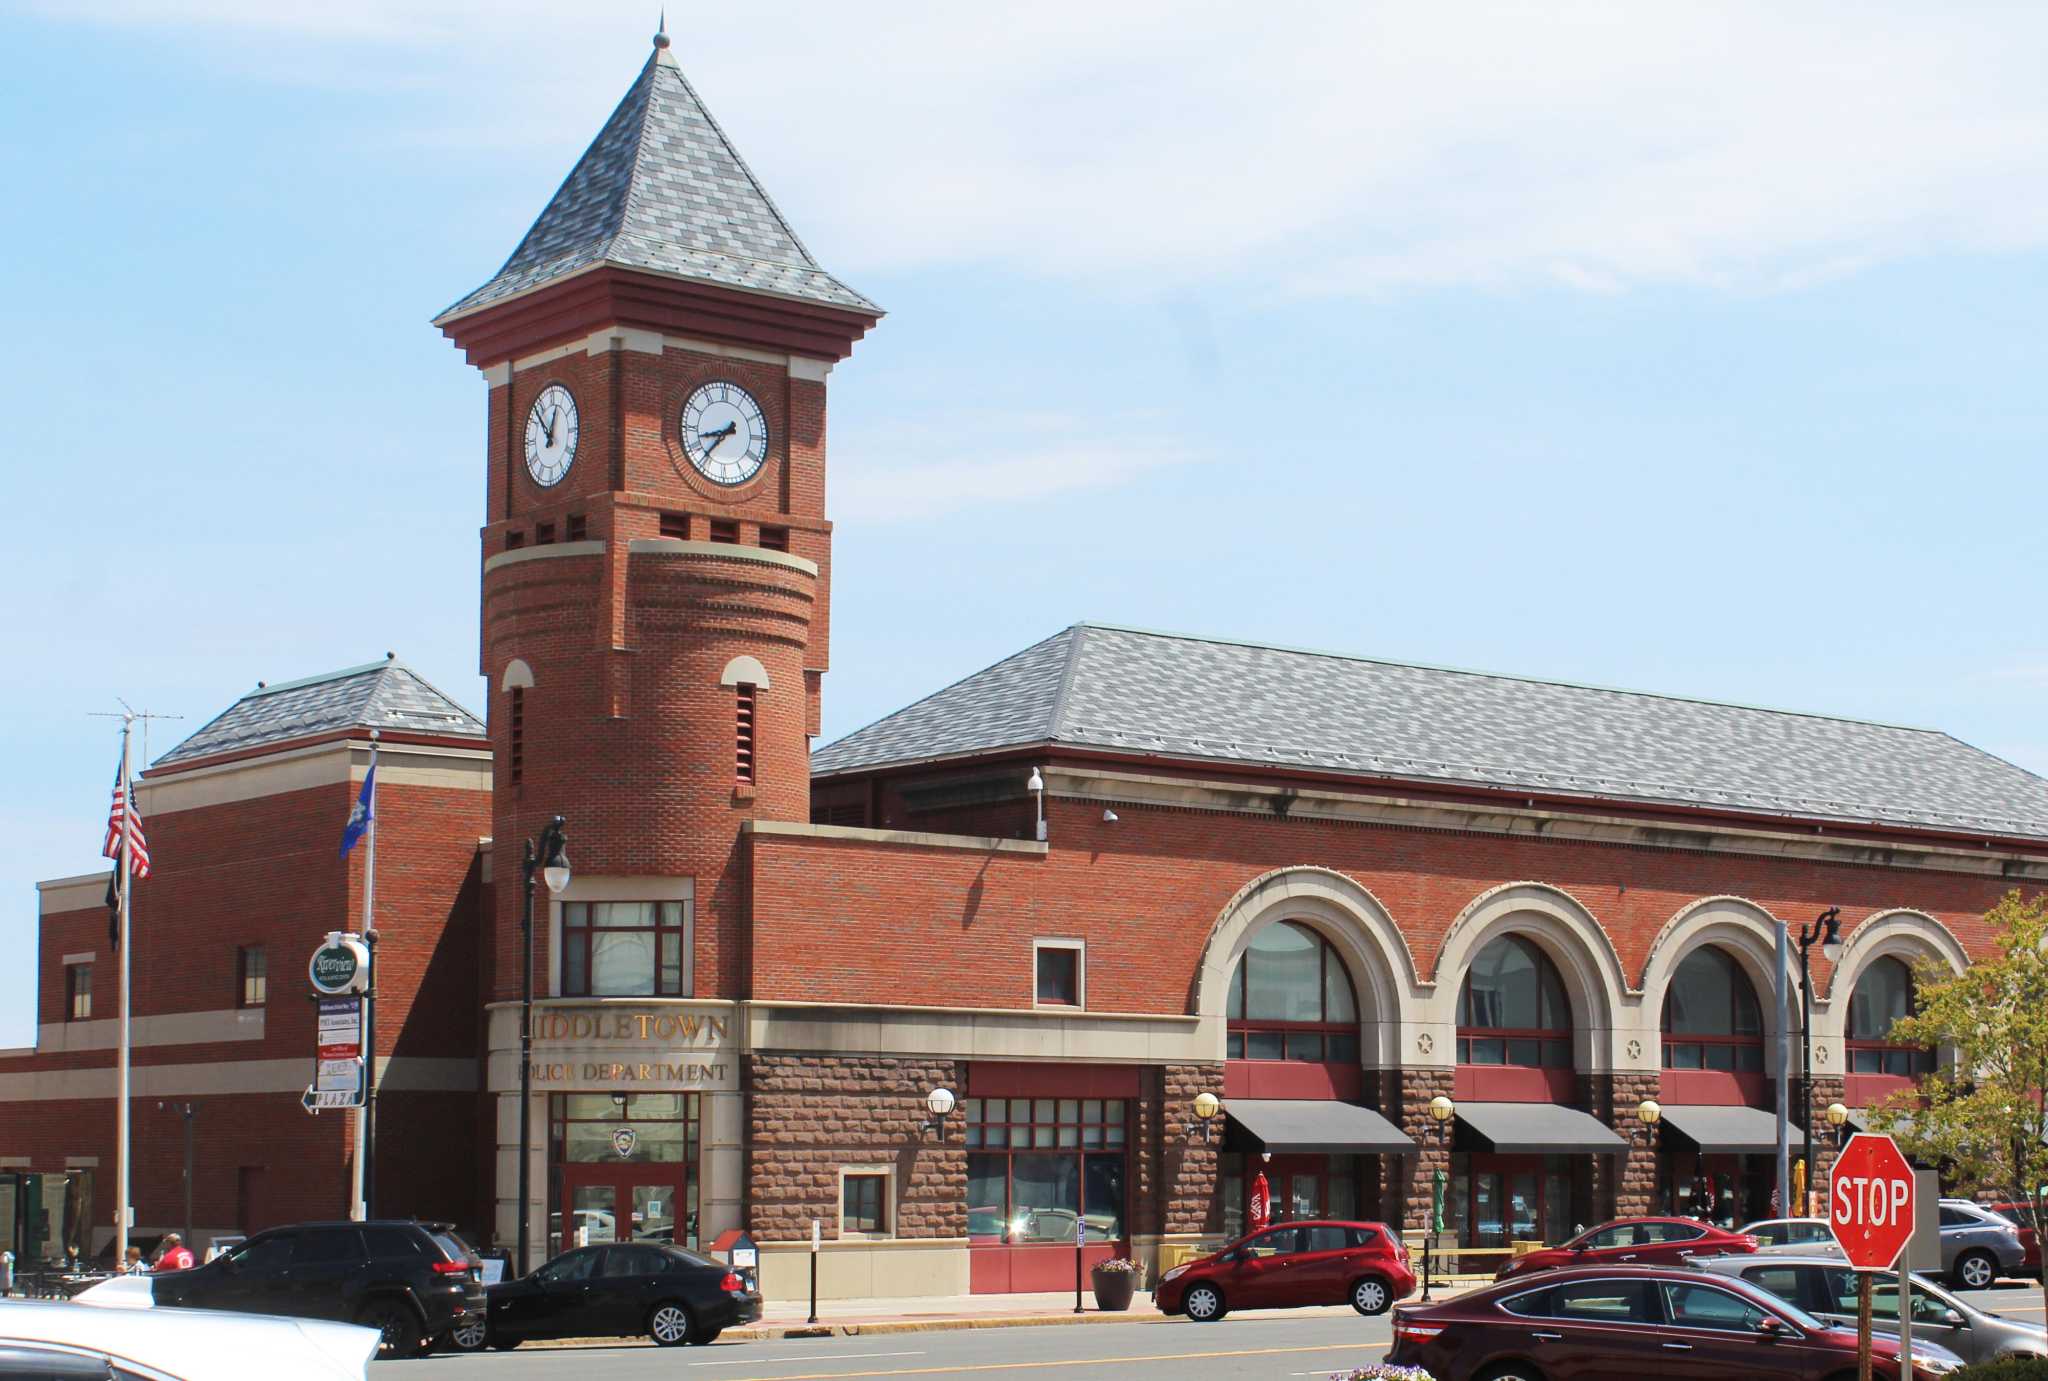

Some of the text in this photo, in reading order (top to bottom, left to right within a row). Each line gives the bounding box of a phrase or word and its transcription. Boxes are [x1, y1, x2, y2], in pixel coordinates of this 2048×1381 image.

[583, 1063, 729, 1082] DEPARTMENT
[316, 1092, 354, 1106] PLAZA
[1835, 1176, 1910, 1227] STOP
